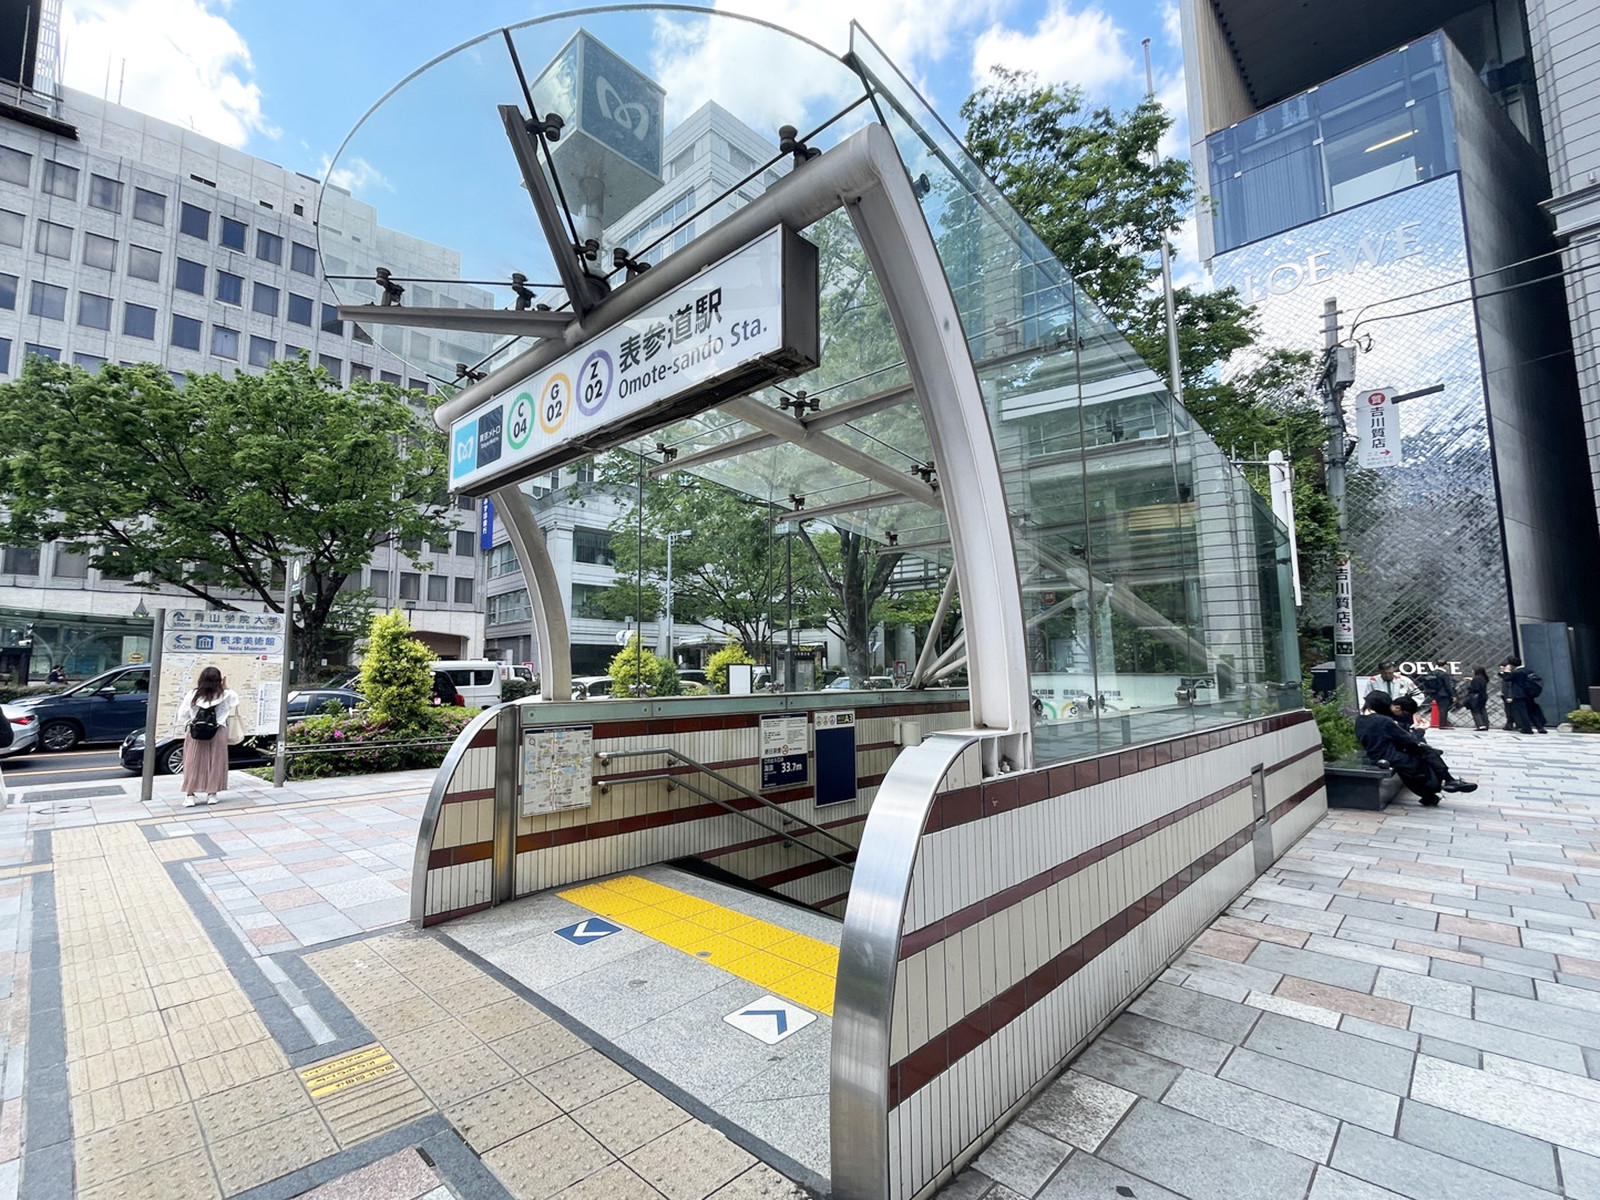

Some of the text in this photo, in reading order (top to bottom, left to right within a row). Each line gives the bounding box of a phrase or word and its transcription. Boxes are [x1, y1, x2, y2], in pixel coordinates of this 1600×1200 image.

[1244, 221, 1424, 306] LOEWE
[618, 287, 722, 374] 表参道駅
[618, 318, 768, 399] Omote-sando Sta.
[590, 360, 599, 380] Z
[550, 383, 560, 401] G
[585, 379, 603, 404] 02
[518, 401, 525, 418] C
[546, 400, 563, 422] 02
[479, 424, 501, 443] 東京メトロ
[513, 418, 528, 439] 04
[1370, 406, 1386, 449] 吉川質店
[1335, 568, 1350, 624] 吉川質店
[194, 612, 279, 625] 青山学院大学
[220, 635, 276, 646] 根津美術館
[1398, 661, 1462, 675] OEWE
[781, 762, 802, 773] 33.7m
